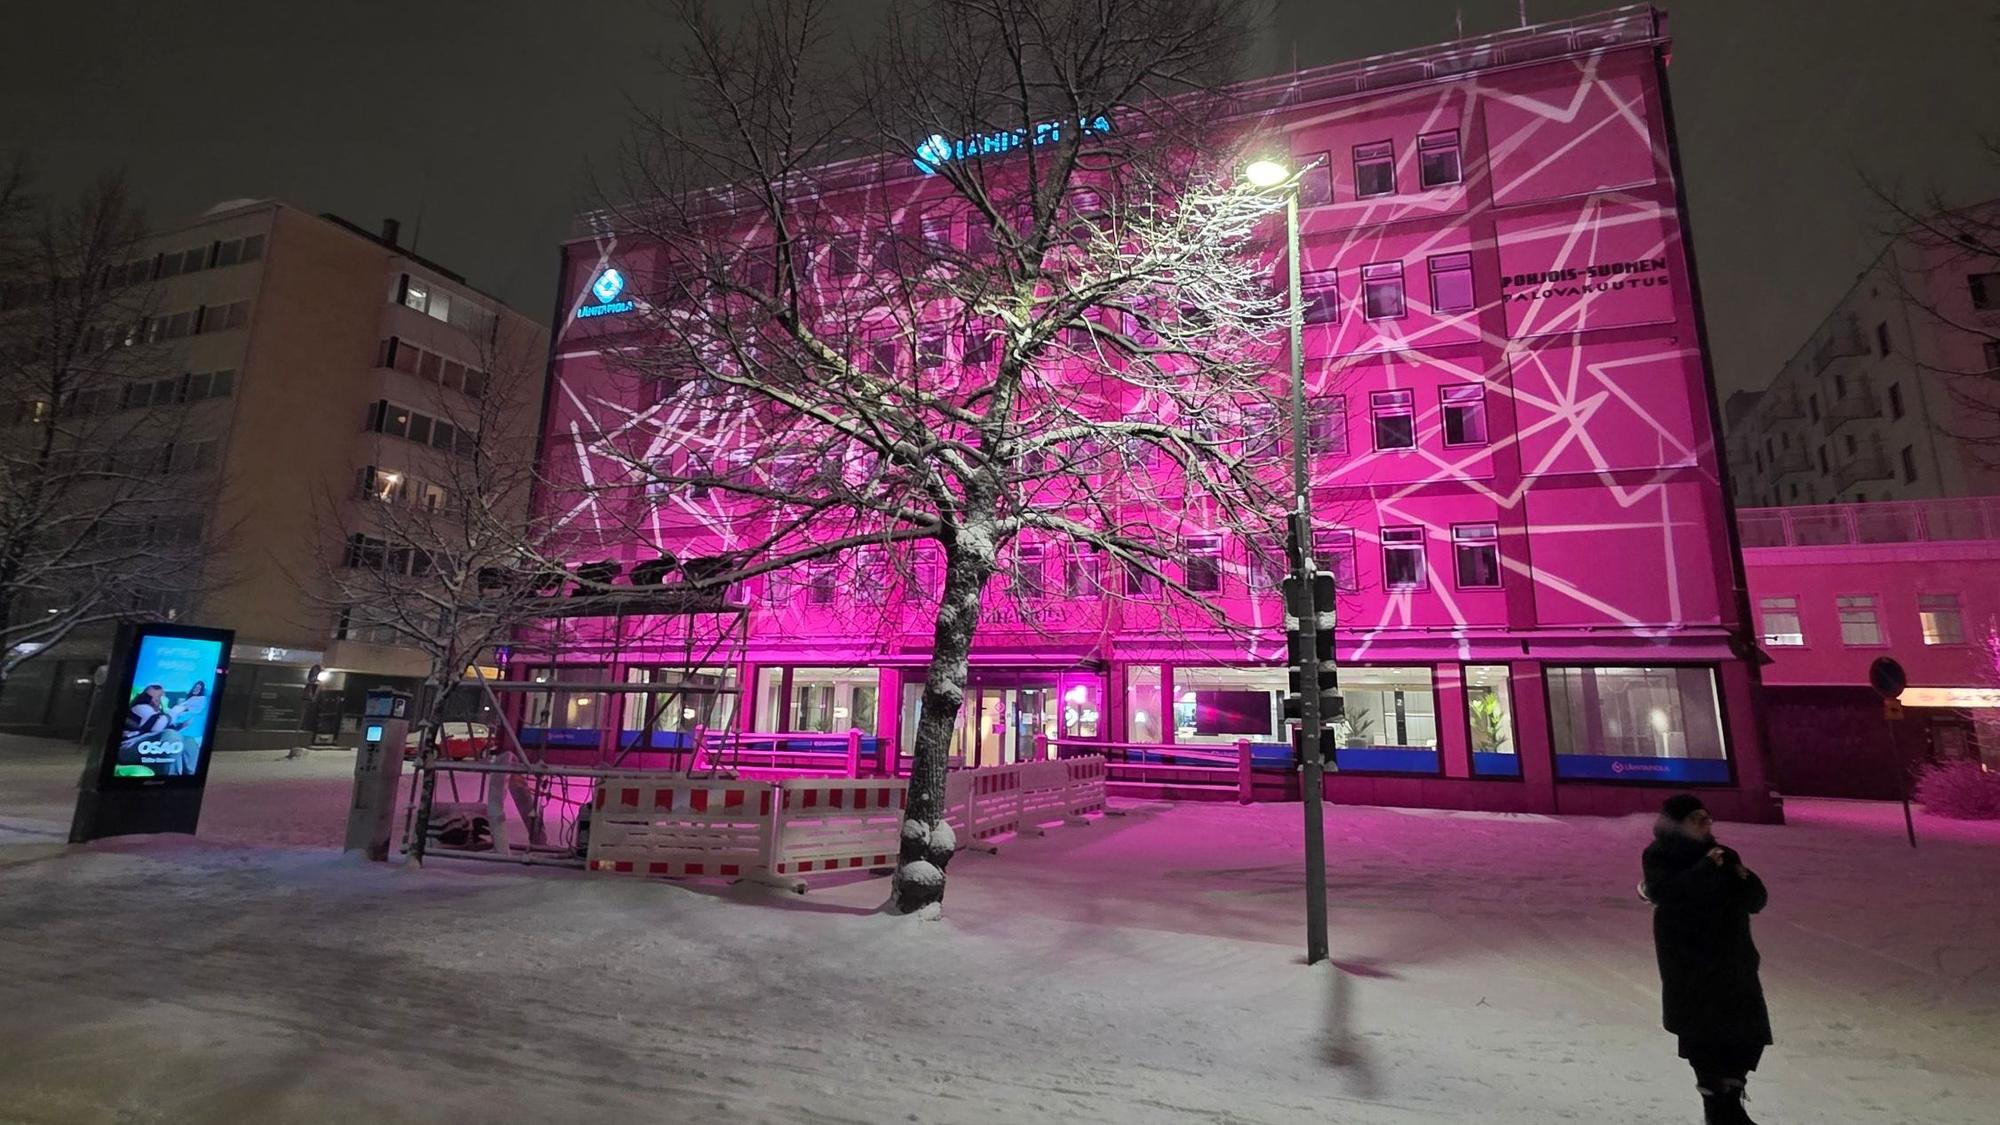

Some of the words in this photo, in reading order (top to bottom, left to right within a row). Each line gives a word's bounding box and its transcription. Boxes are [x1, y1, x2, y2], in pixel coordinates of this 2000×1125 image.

[1502, 257, 1666, 288] POHJOIS-SUOMEN
[1502, 276, 1669, 303] PALOVAKUUTUS
[138, 741, 184, 755] OSAO
